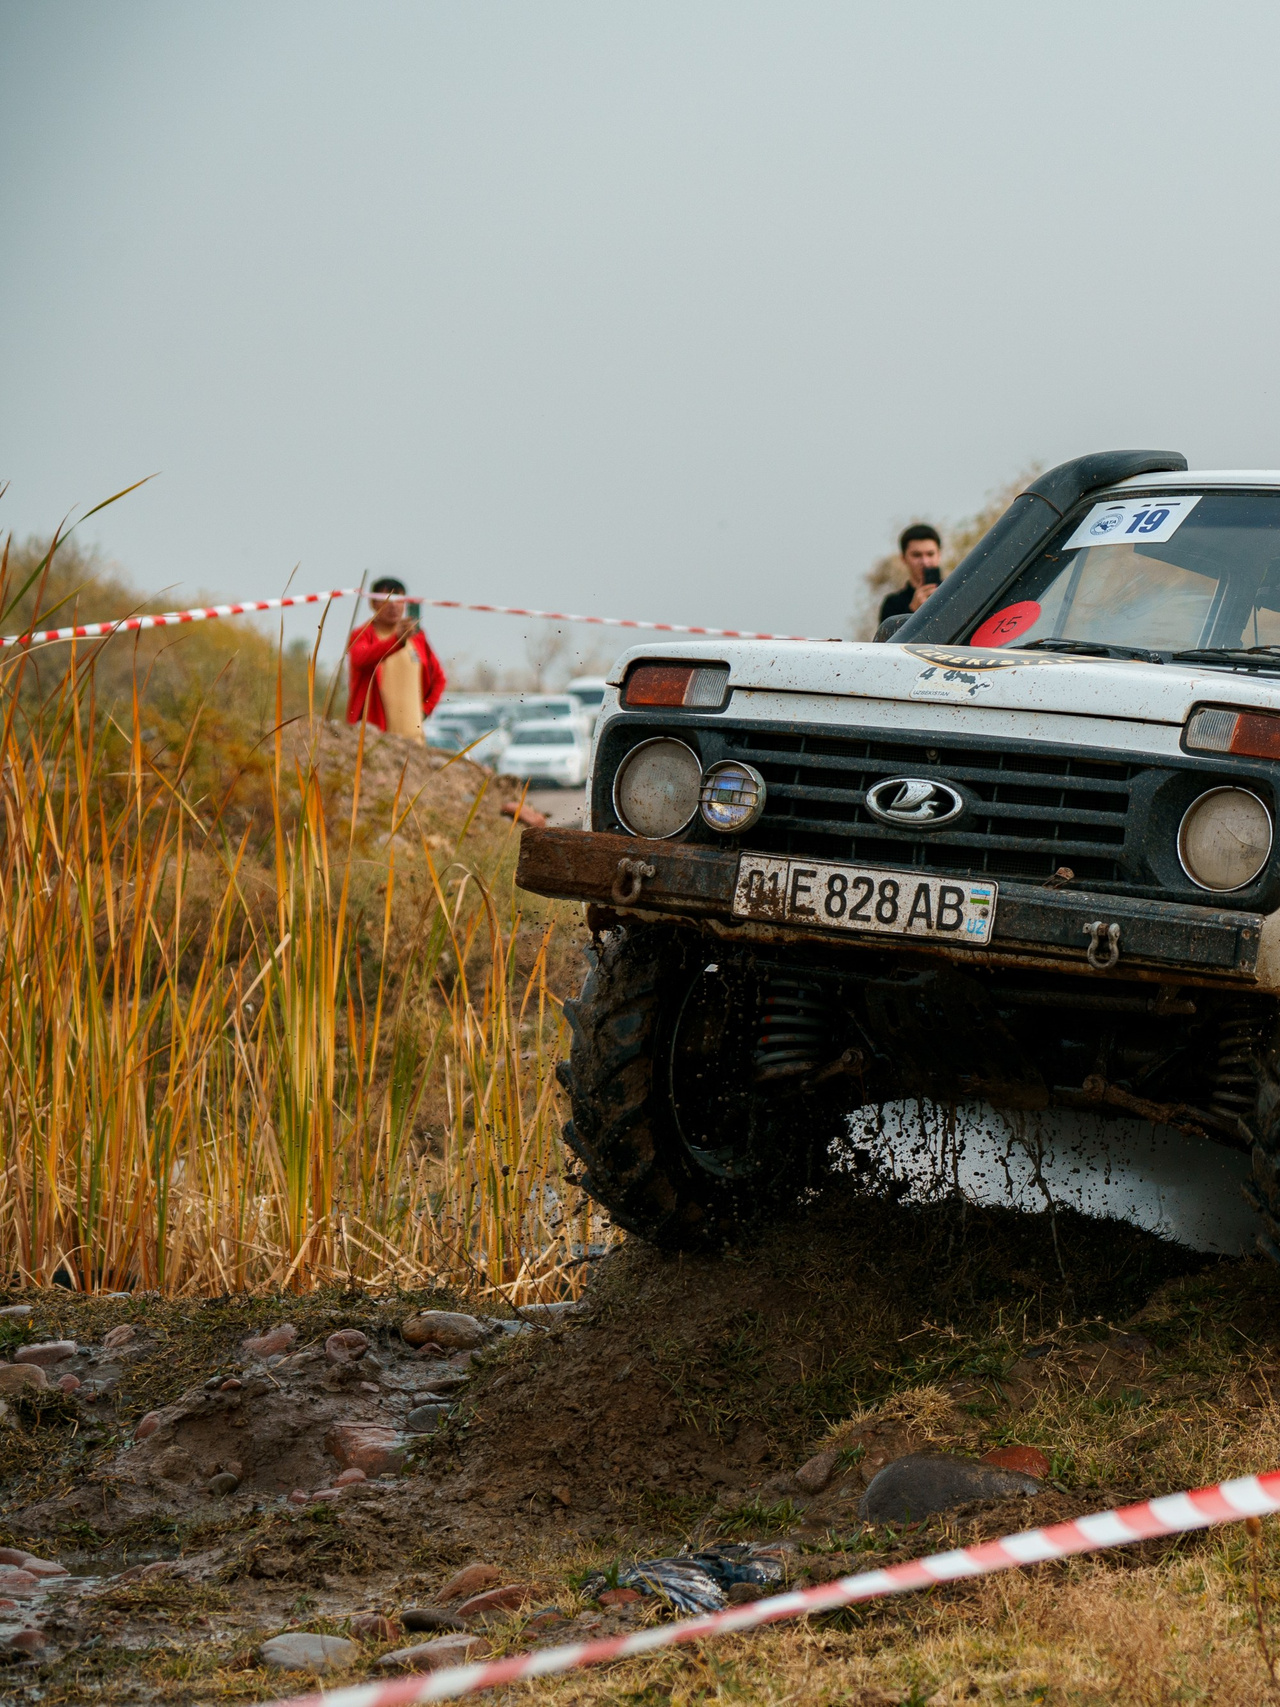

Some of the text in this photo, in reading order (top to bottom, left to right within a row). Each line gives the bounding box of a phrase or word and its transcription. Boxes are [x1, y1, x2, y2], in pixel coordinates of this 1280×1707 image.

[1125, 509, 1170, 534] 19
[992, 616, 1022, 634] 15
[790, 868, 818, 916] E
[824, 873, 901, 925] 828
[907, 882, 966, 932] AB
[966, 918, 986, 935] UZ
